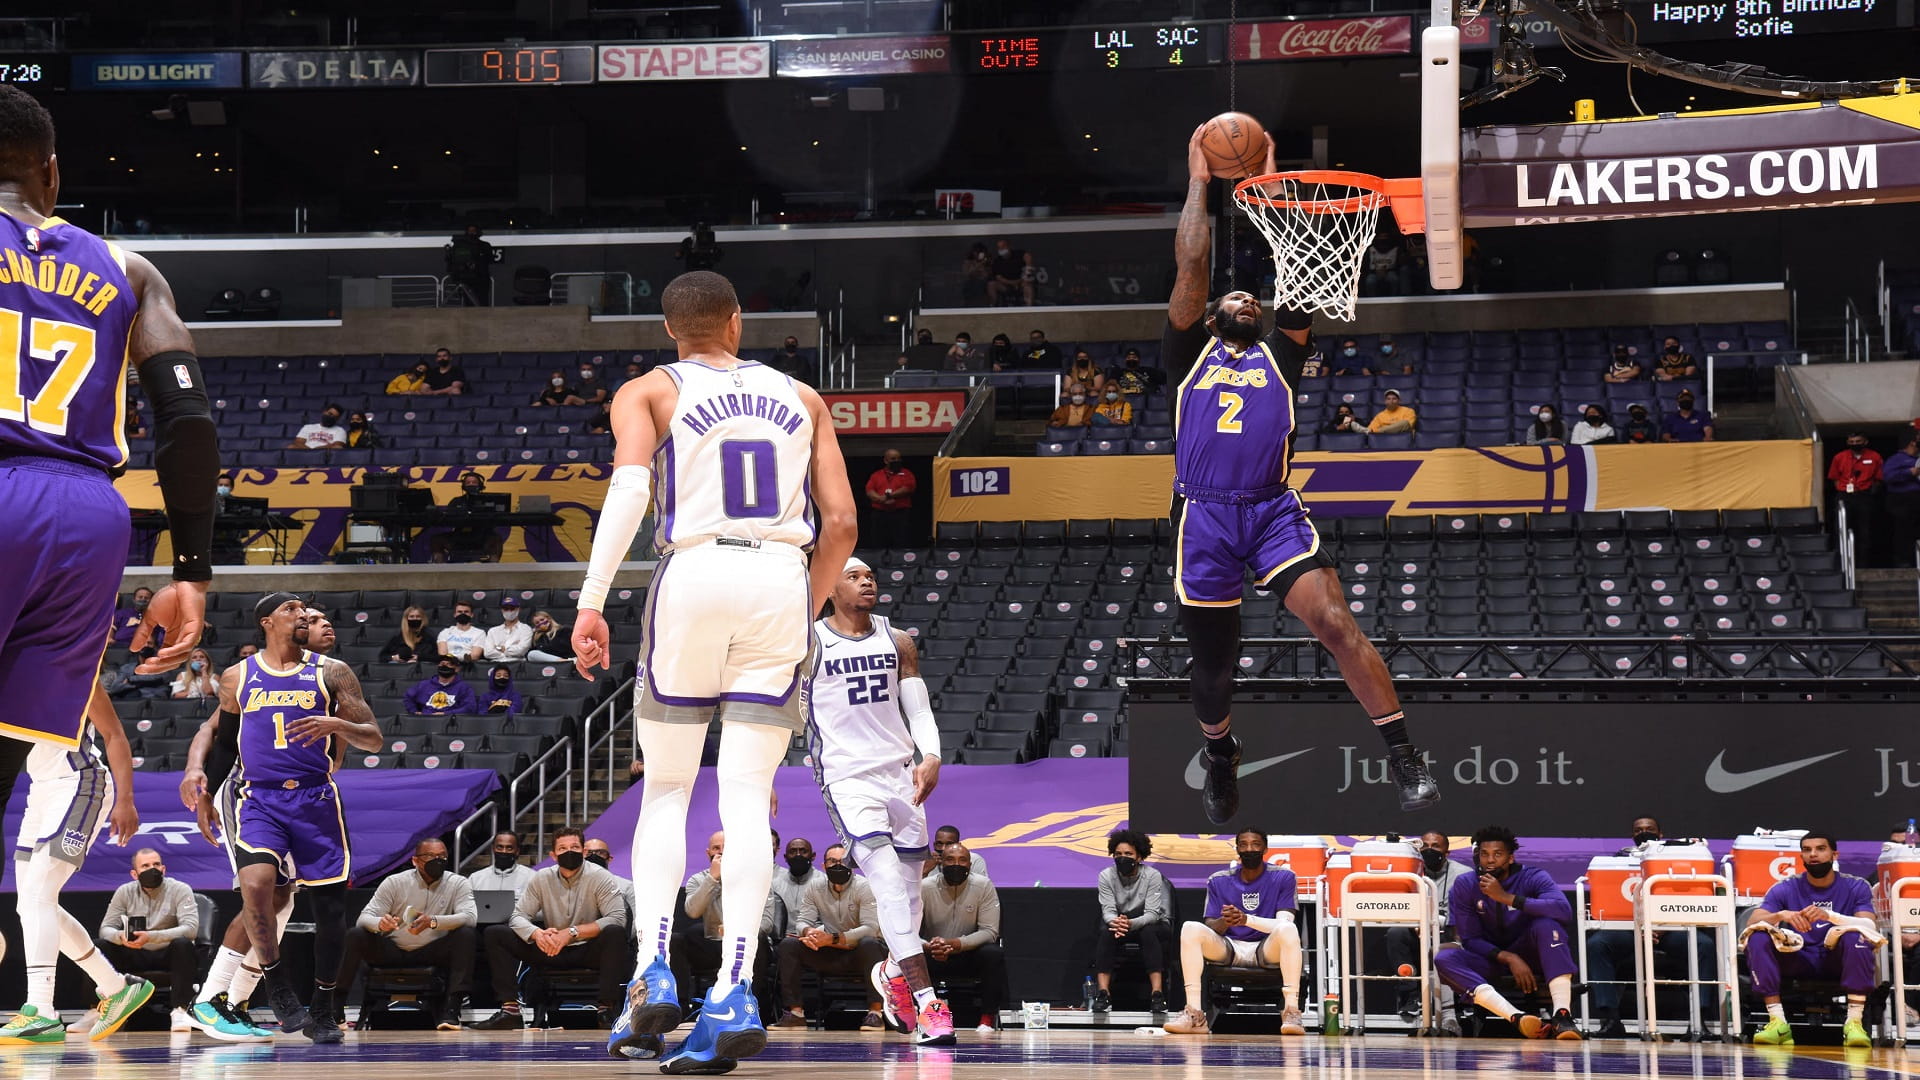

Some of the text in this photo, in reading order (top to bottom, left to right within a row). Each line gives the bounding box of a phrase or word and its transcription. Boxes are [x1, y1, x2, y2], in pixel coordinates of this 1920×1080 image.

[1653, 2, 1727, 24] Happy
[1735, 0, 1770, 16] 9th
[1094, 27, 1199, 49] LAL SAC
[1279, 21, 1382, 55] Coca-Cola
[1735, 17, 1793, 38] Sofie
[797, 48, 945, 65] SAN MANUEL CASINO
[981, 39, 1039, 52] TIME
[299, 59, 411, 80] DELTA
[483, 50, 561, 82] 9:05
[602, 46, 763, 78] STAPLES
[981, 54, 1039, 68] OUTS
[1106, 48, 1183, 68] 3 4
[97, 64, 214, 81] BUD LIGHT
[1516, 144, 1878, 208] LAKERS.COM
[0, 307, 96, 437] 17
[682, 393, 804, 437] HALIBURTON
[1216, 391, 1244, 434] 2
[719, 438, 782, 520] 0
[959, 470, 999, 493] 102
[824, 653, 897, 676] KINGS
[243, 687, 317, 713] LAKERS
[846, 673, 890, 706] 22
[272, 712, 289, 750] 1
[1336, 745, 1585, 793] Jut do it.
[63, 837, 84, 849] SAC
[1769, 857, 1796, 881] G
[1356, 902, 1411, 911] GATORADE
[1660, 904, 1718, 913] GATORADE
